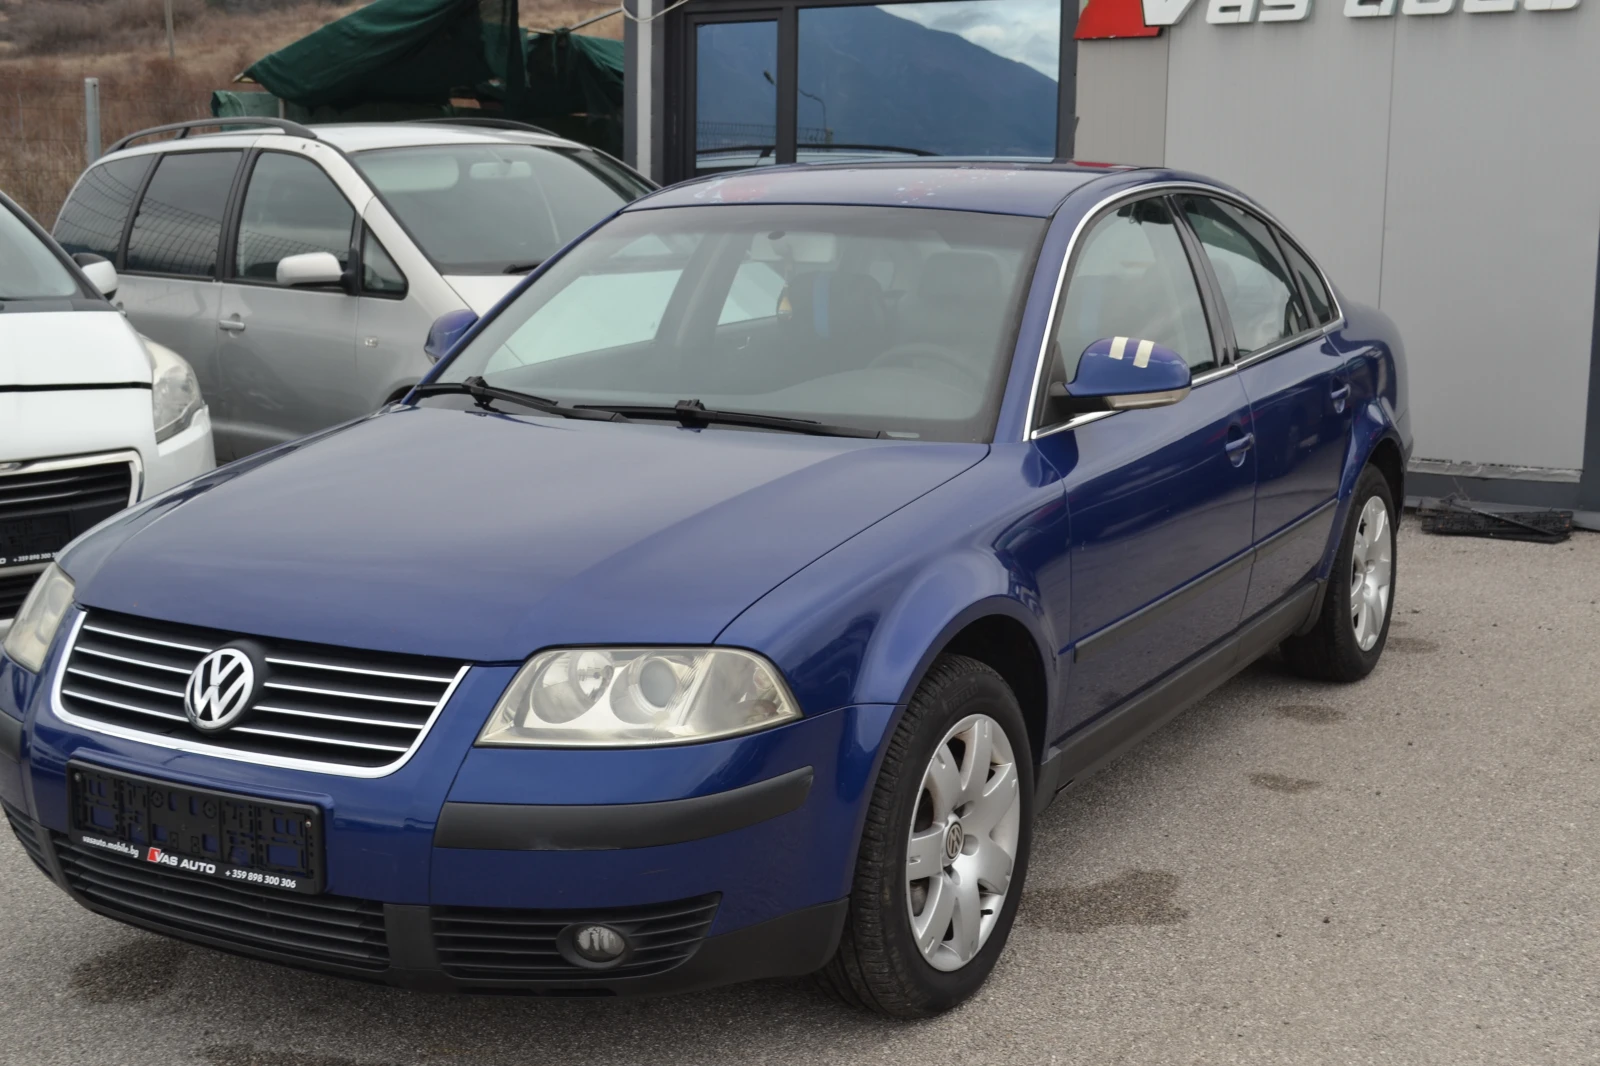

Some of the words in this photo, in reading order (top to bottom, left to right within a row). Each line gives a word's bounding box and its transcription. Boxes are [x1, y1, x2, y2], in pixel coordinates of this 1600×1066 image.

[180, 859, 216, 874] AUTO
[247, 872, 263, 883] 898
[263, 875, 280, 886] 300
[280, 878, 297, 889] 306
